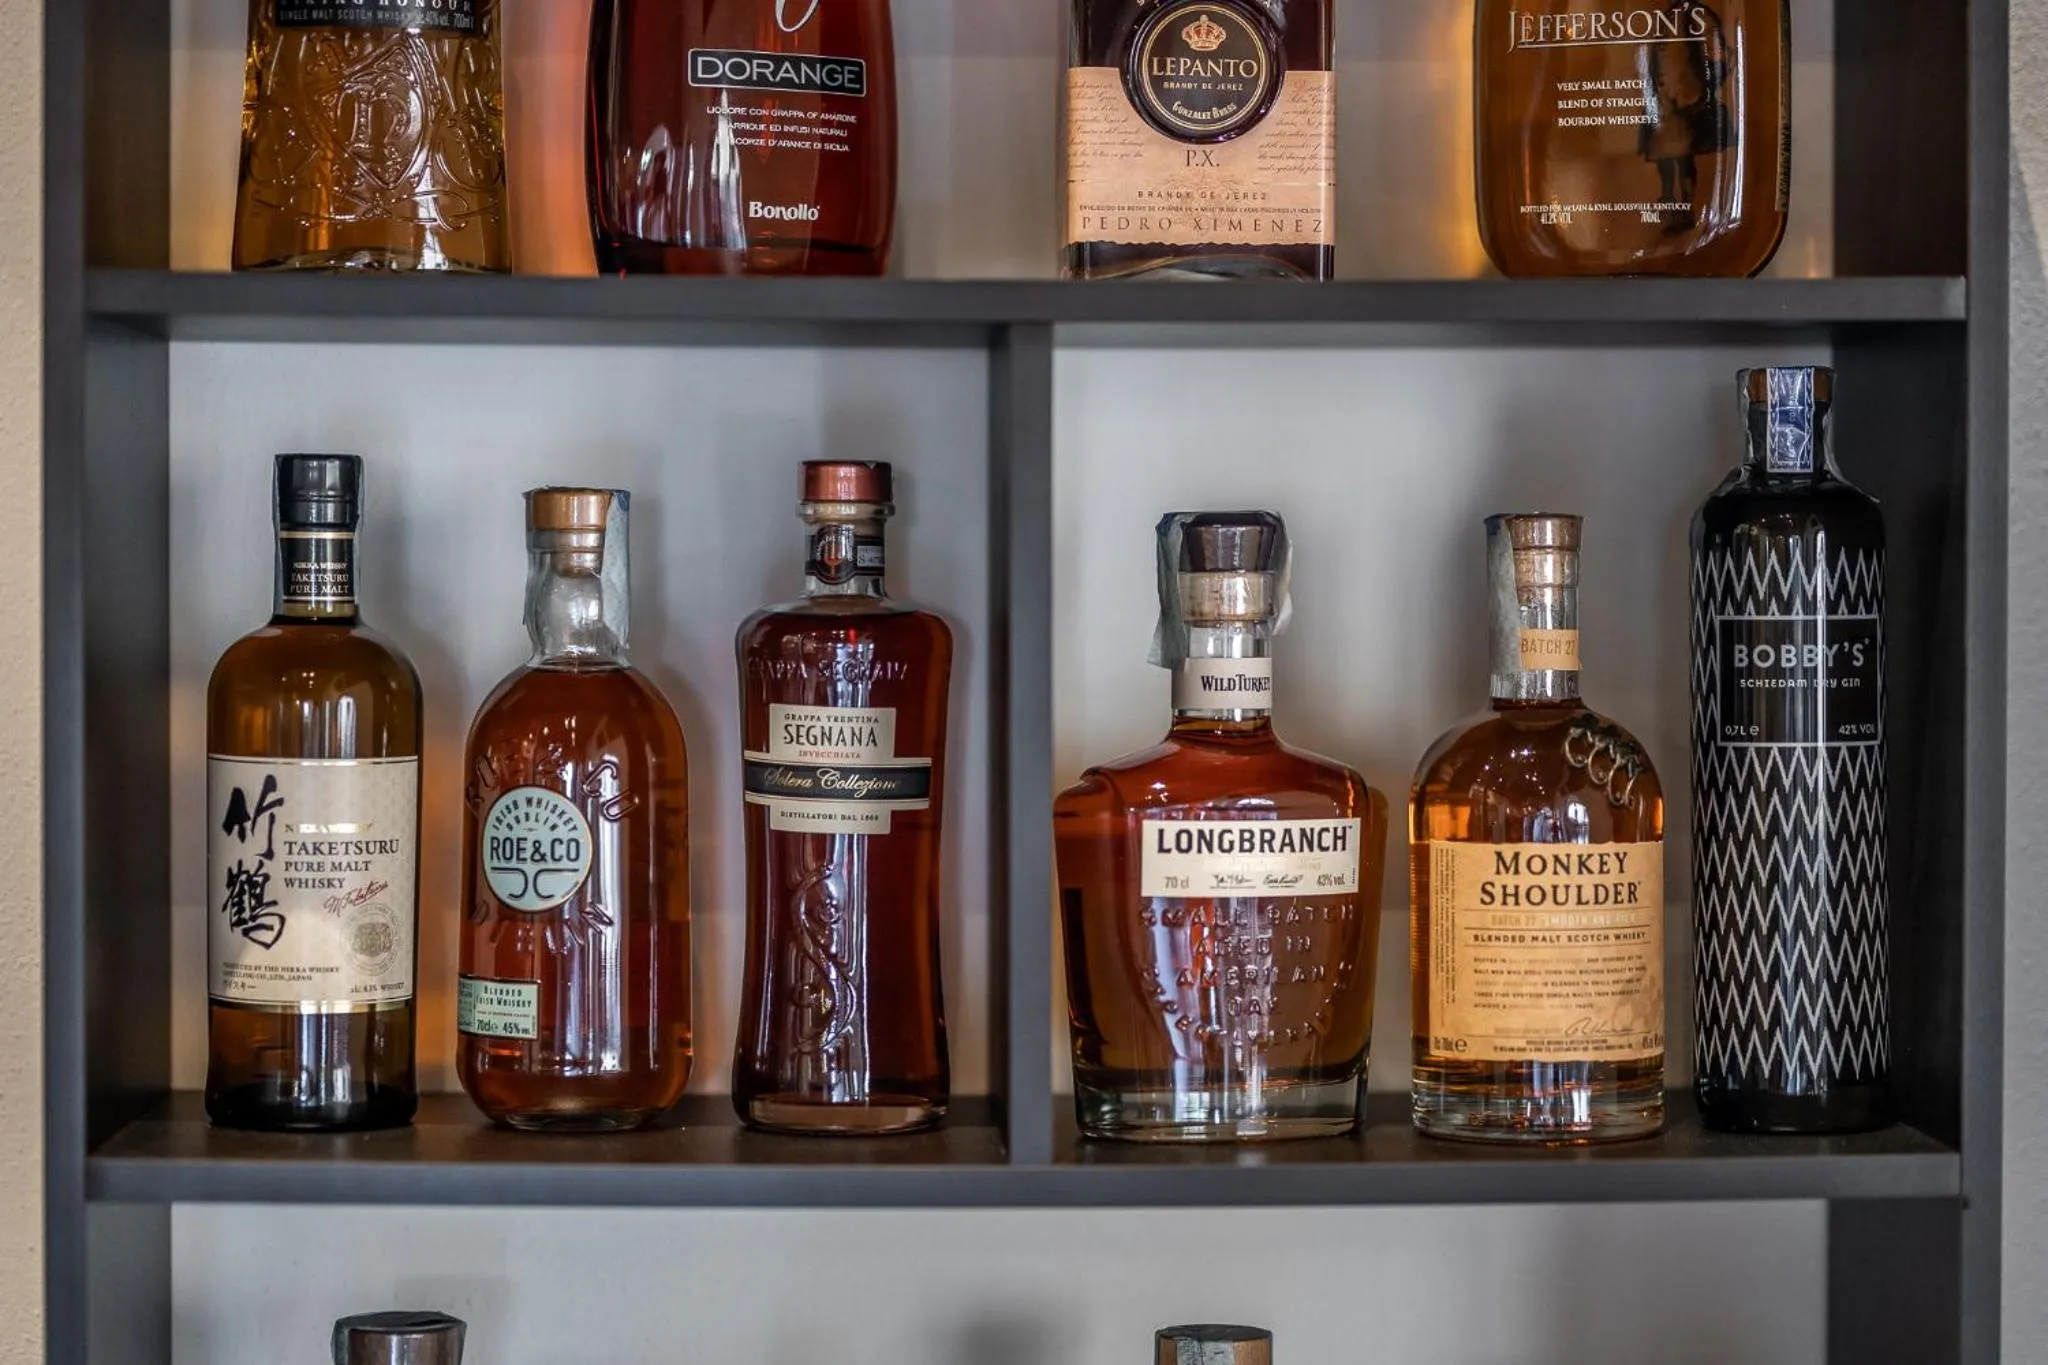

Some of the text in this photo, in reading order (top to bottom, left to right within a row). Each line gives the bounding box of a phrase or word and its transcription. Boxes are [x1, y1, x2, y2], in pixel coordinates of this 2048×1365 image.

[1507, 2, 1706, 53] JEFFERSON'S
[697, 56, 861, 88] DORANGE
[1152, 57, 1258, 78] LEPANTO
[1163, 82, 1198, 90] BRANDY
[1216, 83, 1244, 91] JEREZ
[1557, 79, 1646, 91] VERY SMALL BATCH
[1557, 97, 1657, 109] BLEND OF STRAIGHT
[749, 107, 770, 117] CON
[771, 108, 805, 119] GRAPPA
[820, 112, 858, 124] AMARONE
[1558, 114, 1658, 126] BOURBON WHISKEYS
[723, 120, 848, 138] ARRIQUE ED INFUSI NATURALI
[813, 141, 823, 150] DI
[823, 142, 850, 153] SICILIA
[1186, 150, 1220, 167] P.X.
[1138, 190, 1191, 199] BRANDY
[1225, 191, 1267, 200] JEREZ
[749, 202, 820, 221] Bonollo
[1520, 205, 1549, 214] BOTTLED
[1651, 202, 1692, 212] KENTUCKY
[1082, 216, 1323, 233] PEDRO XIMENEZ
[320, 584, 349, 594] MALT
[1521, 637, 1561, 655] BATCH
[1733, 641, 1865, 668] BOBBY'S
[1200, 675, 1236, 692] WILD
[1740, 678, 1861, 689] SCHIEDAM DRY GIN
[784, 713, 880, 724] GRAPPA TRENTINA
[783, 723, 878, 748] SEGNANA
[799, 750, 861, 759] INVECCHIATA
[492, 796, 579, 833] IRISH WHISKEY
[506, 812, 558, 832] DUBLIN
[780, 810, 838, 820] DISTILLATORI
[840, 813, 857, 821] DAL
[283, 839, 400, 856] TAKETSURU
[1157, 826, 1347, 855] LONGBRANCH
[284, 860, 372, 872] PURE MALT
[1494, 851, 1628, 876] MONKEY
[283, 877, 346, 889] WHISKY
[1480, 881, 1638, 907] SHOULDER
[1473, 931, 1647, 944] BLENDED MALT SCOTCH WHISKY
